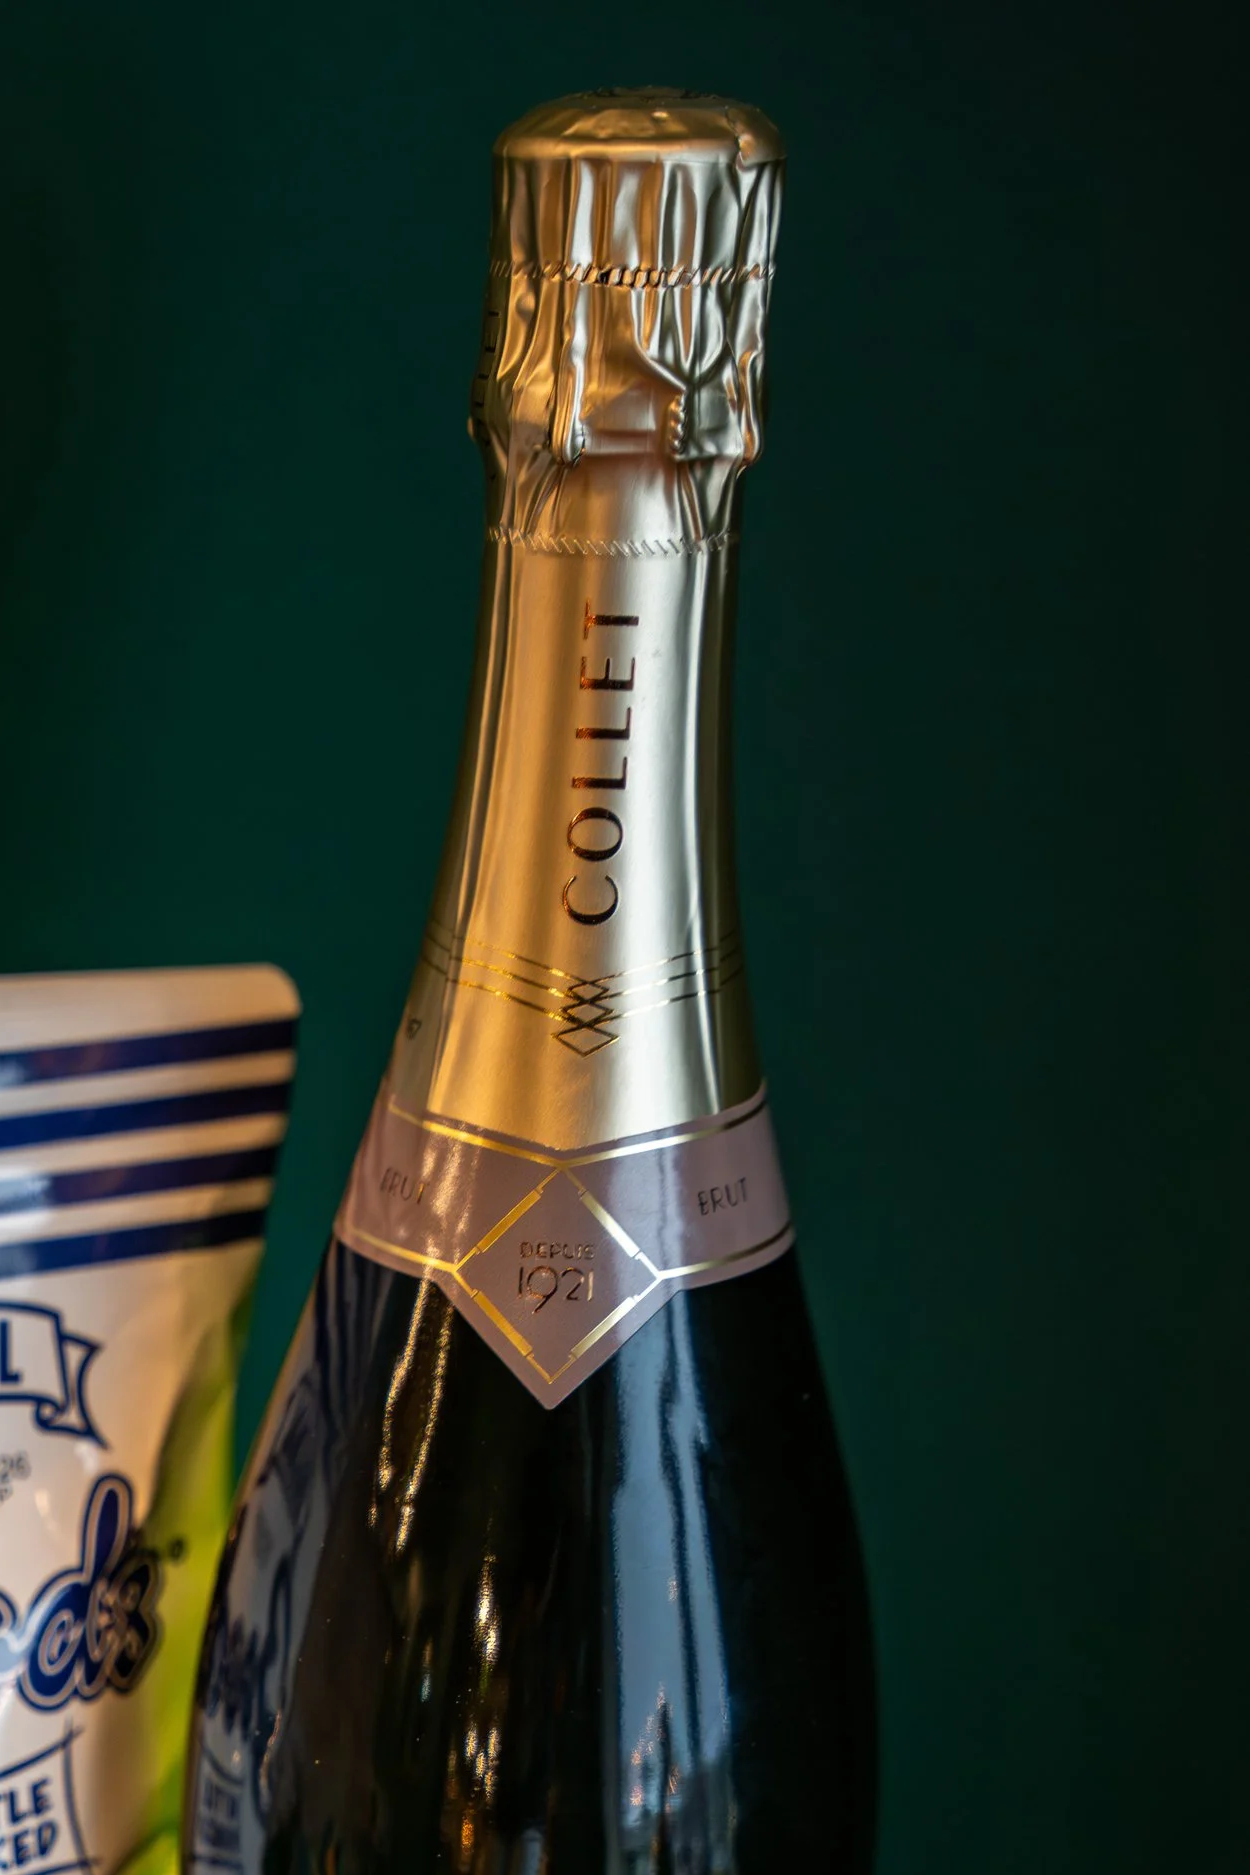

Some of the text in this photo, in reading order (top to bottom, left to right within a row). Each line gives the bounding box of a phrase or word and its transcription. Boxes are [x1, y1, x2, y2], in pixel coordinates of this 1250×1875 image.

[562, 597, 640, 926] COLLET
[697, 1177, 748, 1216] BRUT
[519, 1241, 595, 1260] DEPUIS
[516, 1265, 594, 1314] 1921
